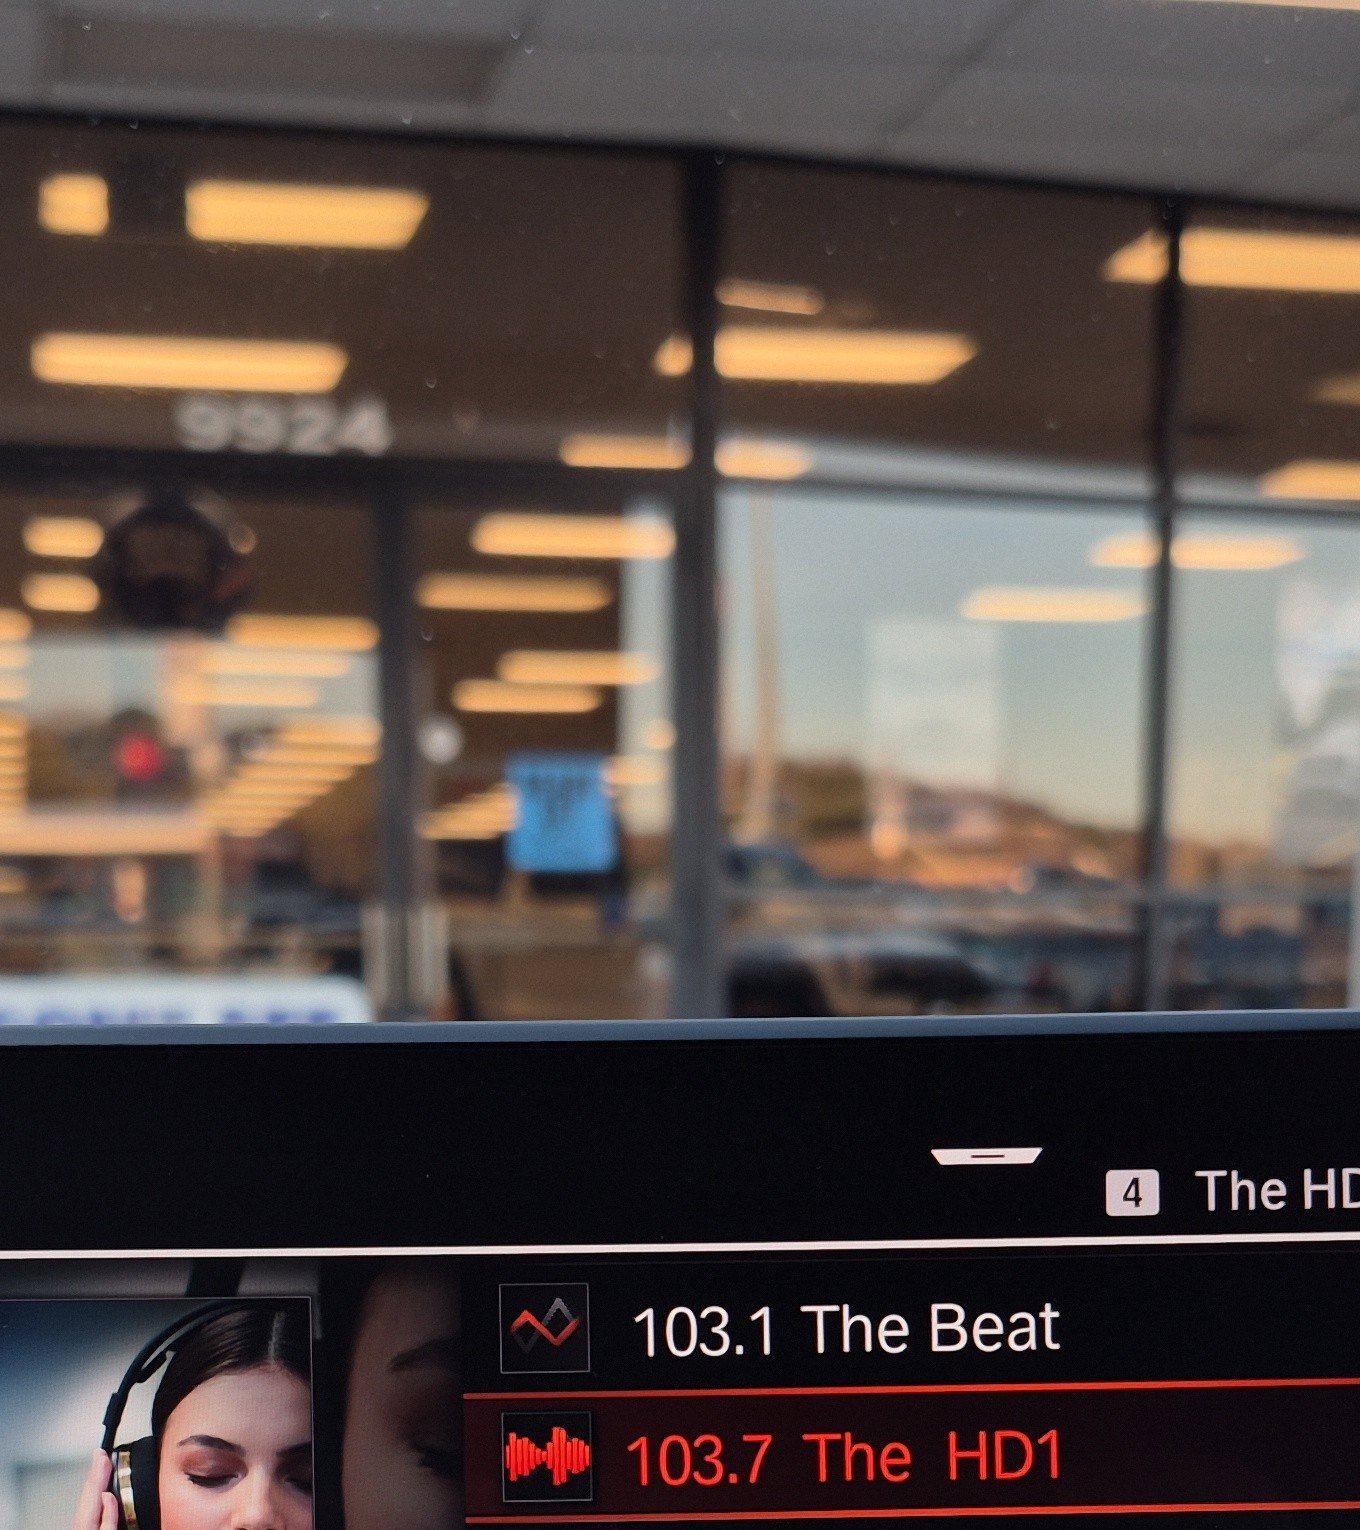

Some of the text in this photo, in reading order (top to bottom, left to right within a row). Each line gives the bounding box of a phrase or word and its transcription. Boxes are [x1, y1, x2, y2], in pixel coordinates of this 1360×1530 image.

[176, 398, 394, 455] 9924
[1122, 1177, 1143, 1208] 4
[1194, 1169, 1287, 1212] The
[633, 1302, 1061, 1358] 103.1 The Beat
[627, 1429, 1059, 1487] 103.7 The HD1
